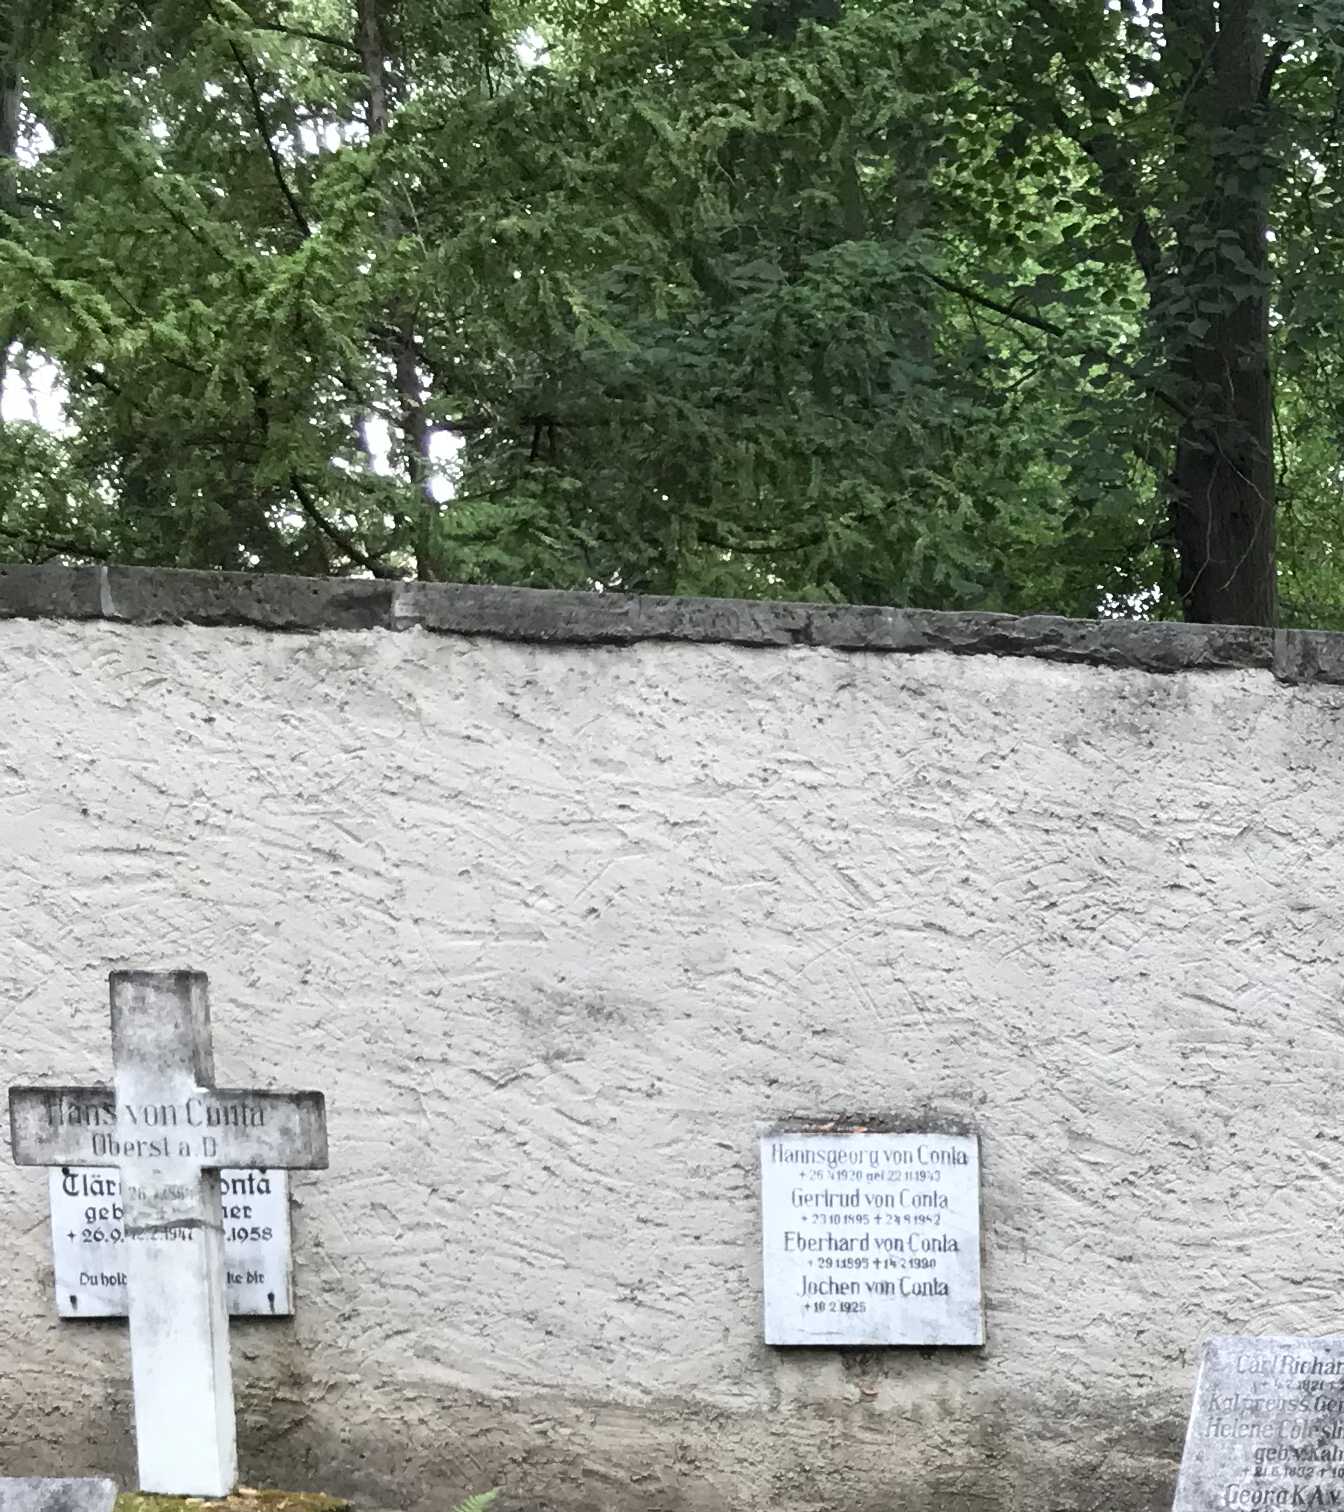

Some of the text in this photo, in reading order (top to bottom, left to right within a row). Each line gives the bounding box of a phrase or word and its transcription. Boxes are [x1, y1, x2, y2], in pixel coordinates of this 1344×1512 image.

[124, 1104, 178, 1128] von
[772, 1144, 968, 1169] Hannsgeorg von Conta
[791, 1187, 949, 1208] Gertrud von Conta
[783, 1231, 960, 1252] Eberhard von Conta
[801, 1275, 949, 1297] Jochen von Conta
